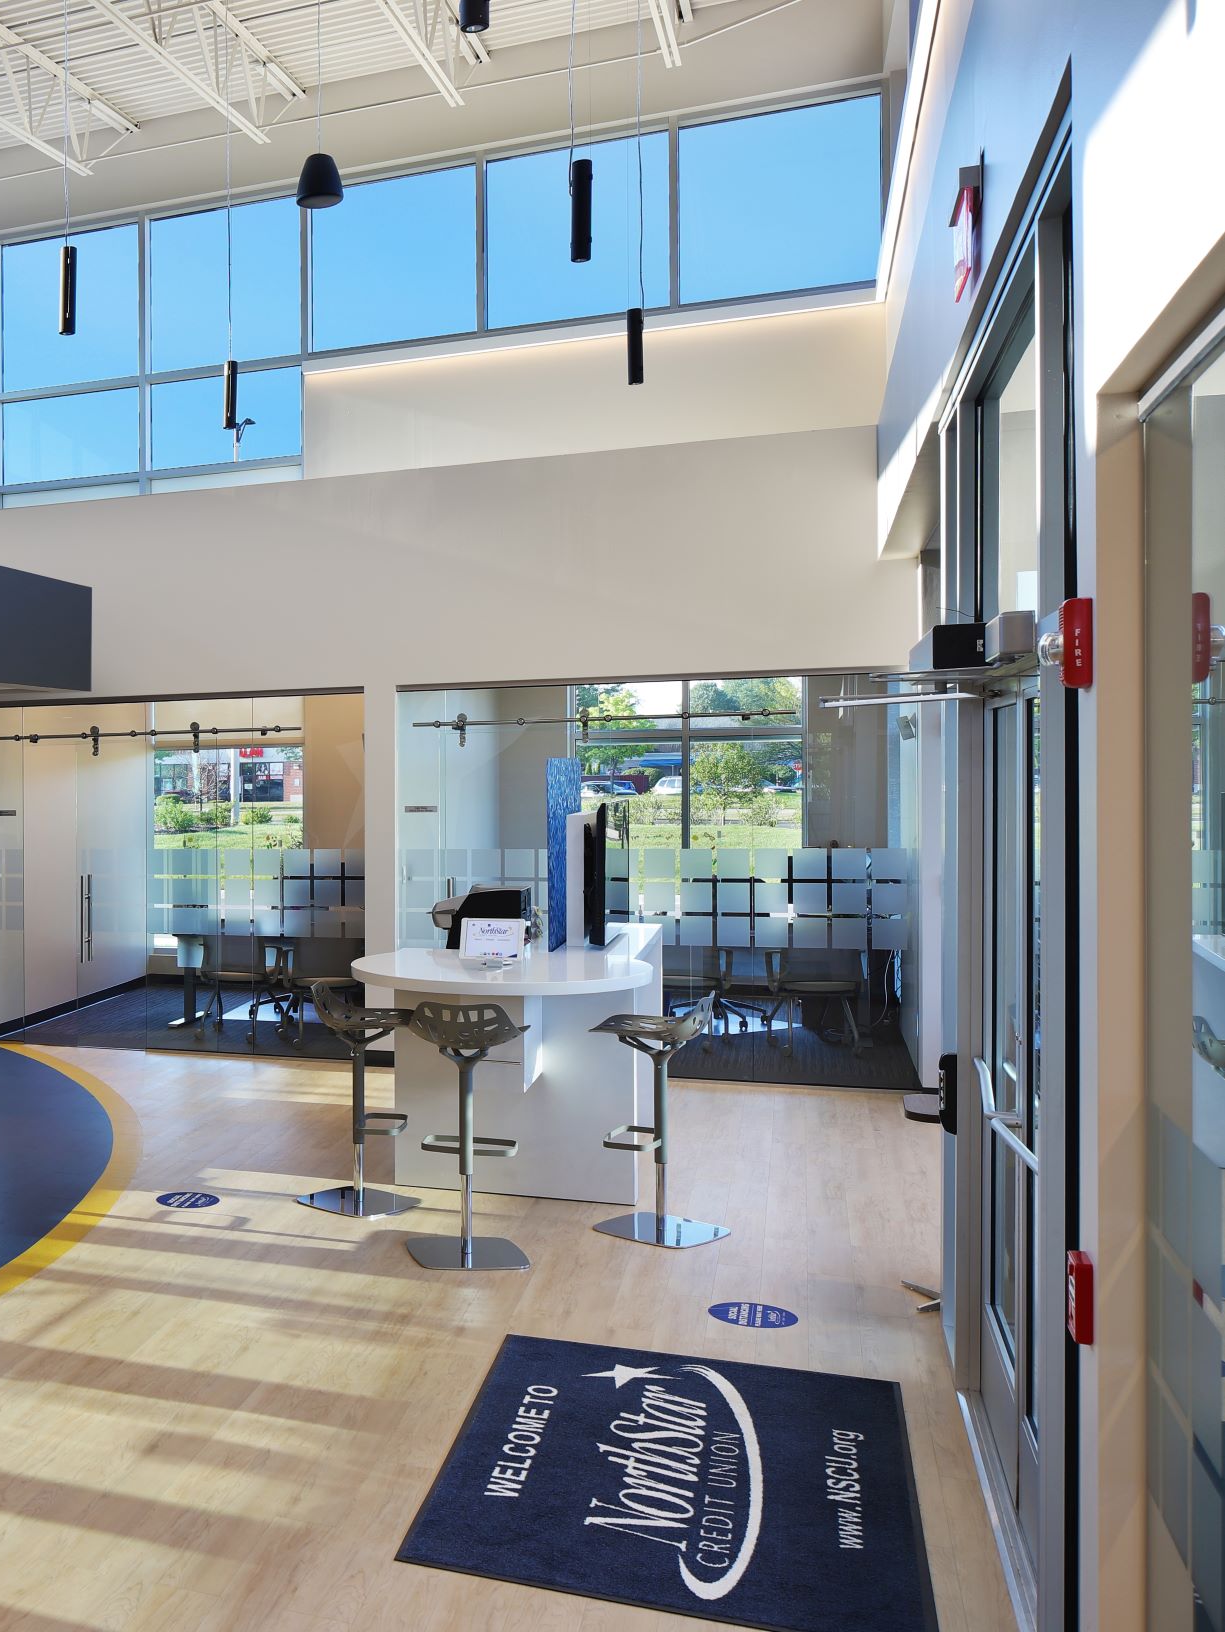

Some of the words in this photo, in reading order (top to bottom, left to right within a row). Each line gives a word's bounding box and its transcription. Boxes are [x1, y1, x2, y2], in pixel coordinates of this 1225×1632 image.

[1074, 628, 1082, 667] FIRE
[483, 1406, 551, 1498] WELCOME
[522, 1385, 559, 1404] TO
[584, 1384, 708, 1552] NorthStar
[707, 1430, 742, 1488] UNION
[696, 1494, 735, 1568] CREDIT
